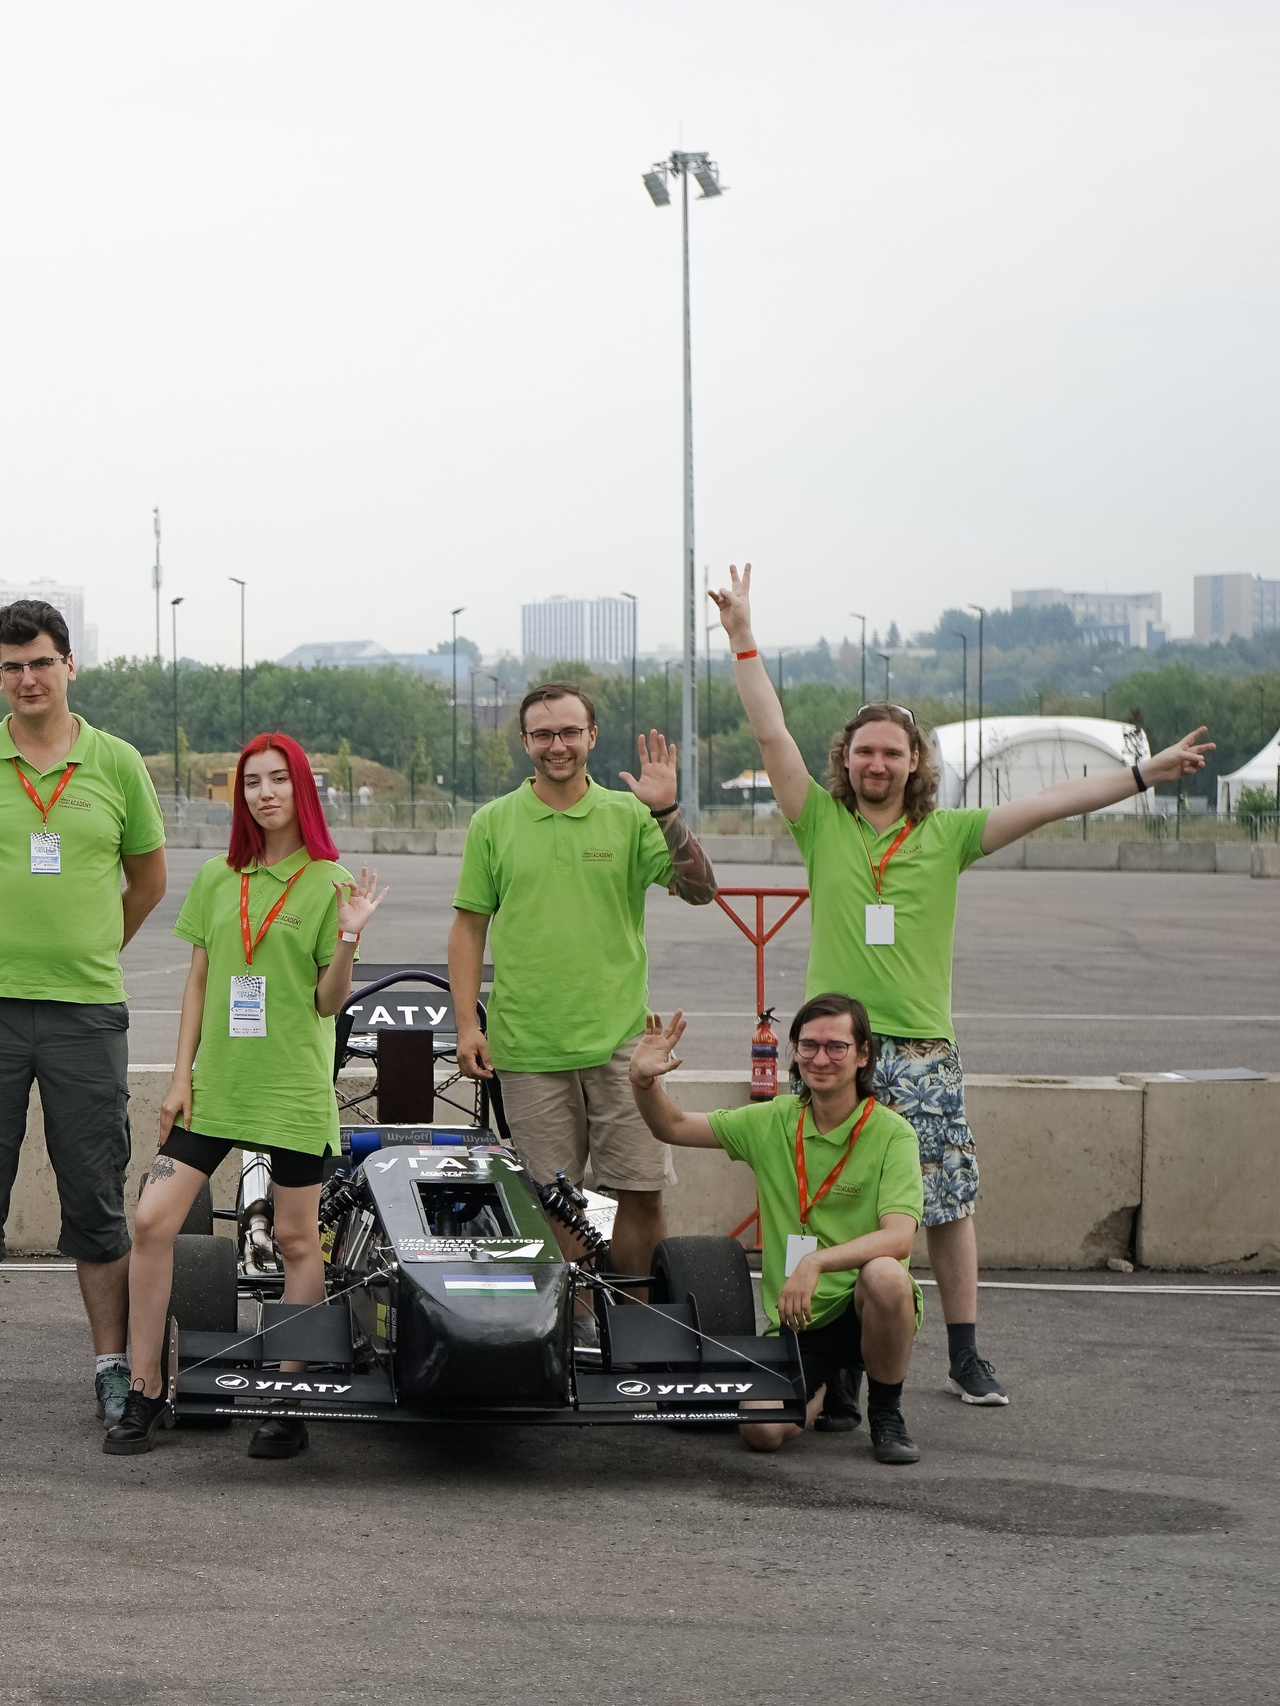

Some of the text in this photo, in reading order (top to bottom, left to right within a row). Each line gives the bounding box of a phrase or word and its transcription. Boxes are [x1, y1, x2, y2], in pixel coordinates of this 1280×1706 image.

[345, 1005, 448, 1026] ГАТУ
[370, 1157, 524, 1173] УГАТУ
[255, 1380, 353, 1394] УГАТУ
[656, 1383, 754, 1395] УГАТУ
